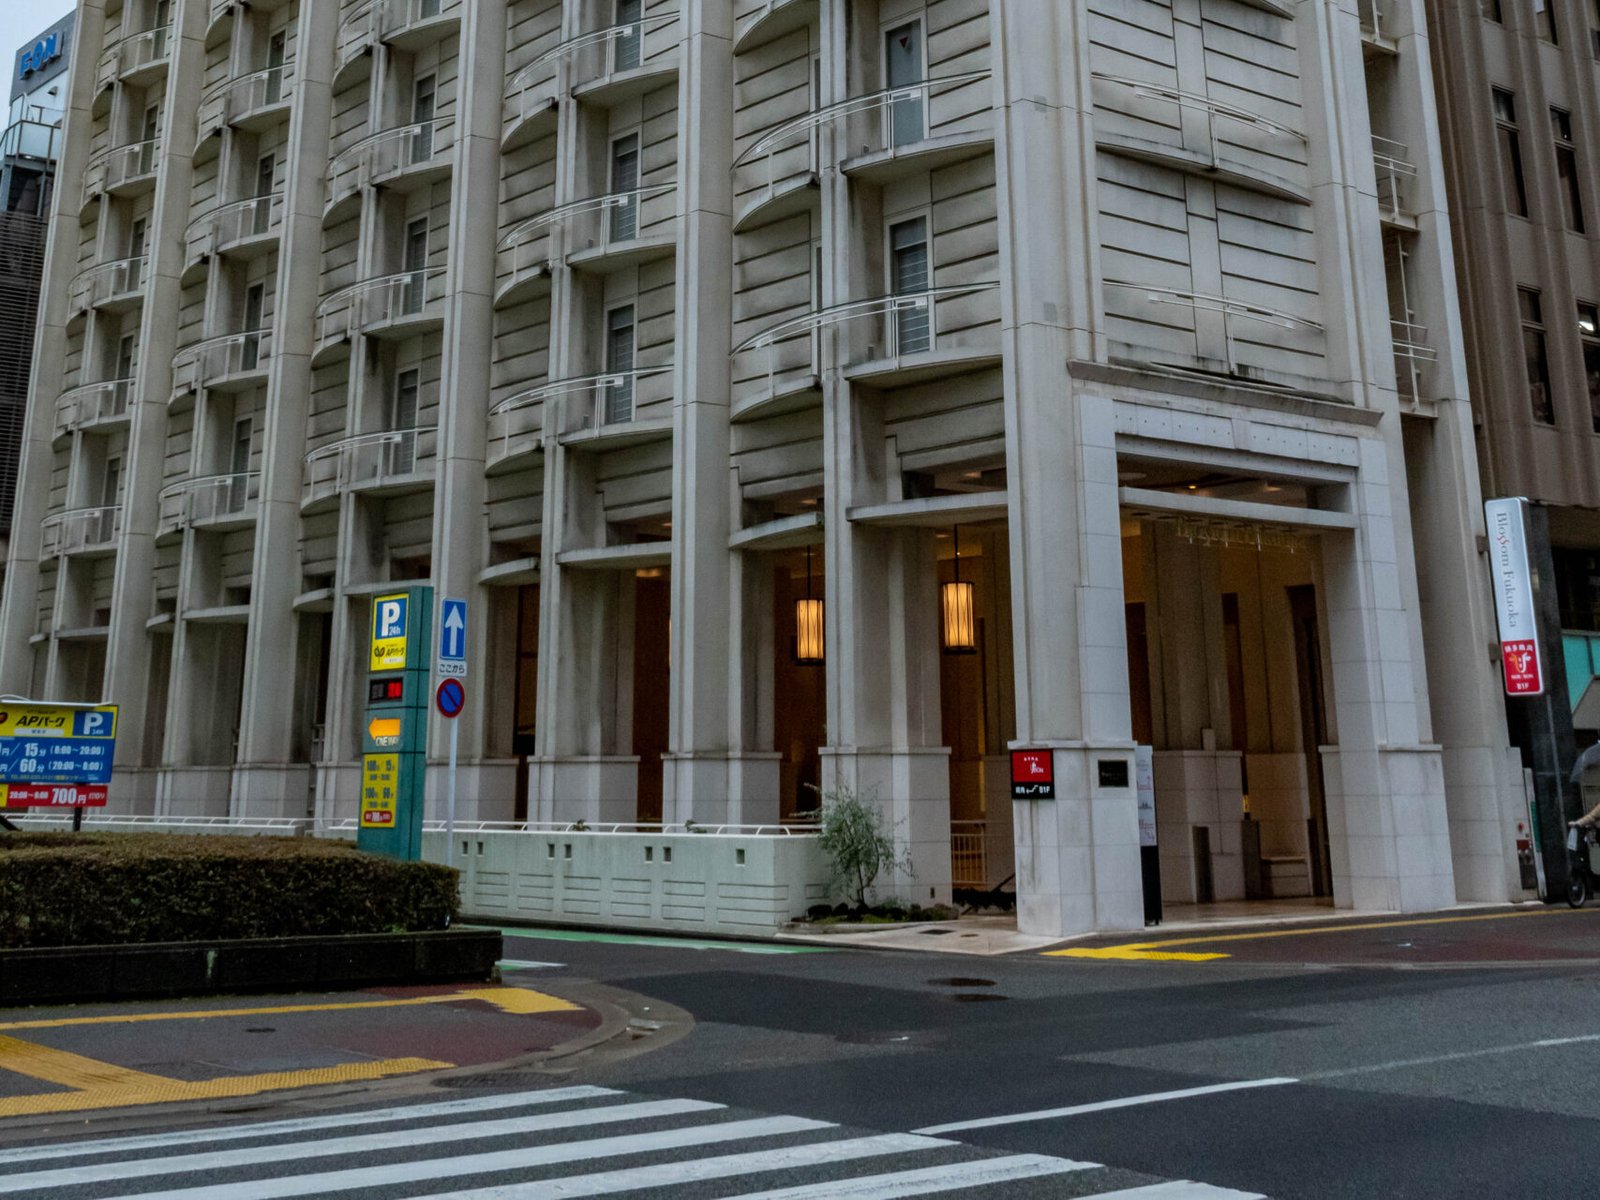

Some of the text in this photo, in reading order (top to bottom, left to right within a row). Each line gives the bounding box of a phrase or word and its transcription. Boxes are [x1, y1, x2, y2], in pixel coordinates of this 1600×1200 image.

[1496, 512, 1519, 628] Blossom Fukuoka
[381, 602, 401, 637] P
[440, 663, 465, 674] ここから
[15, 715, 66, 727] APパーク
[83, 712, 104, 735] P
